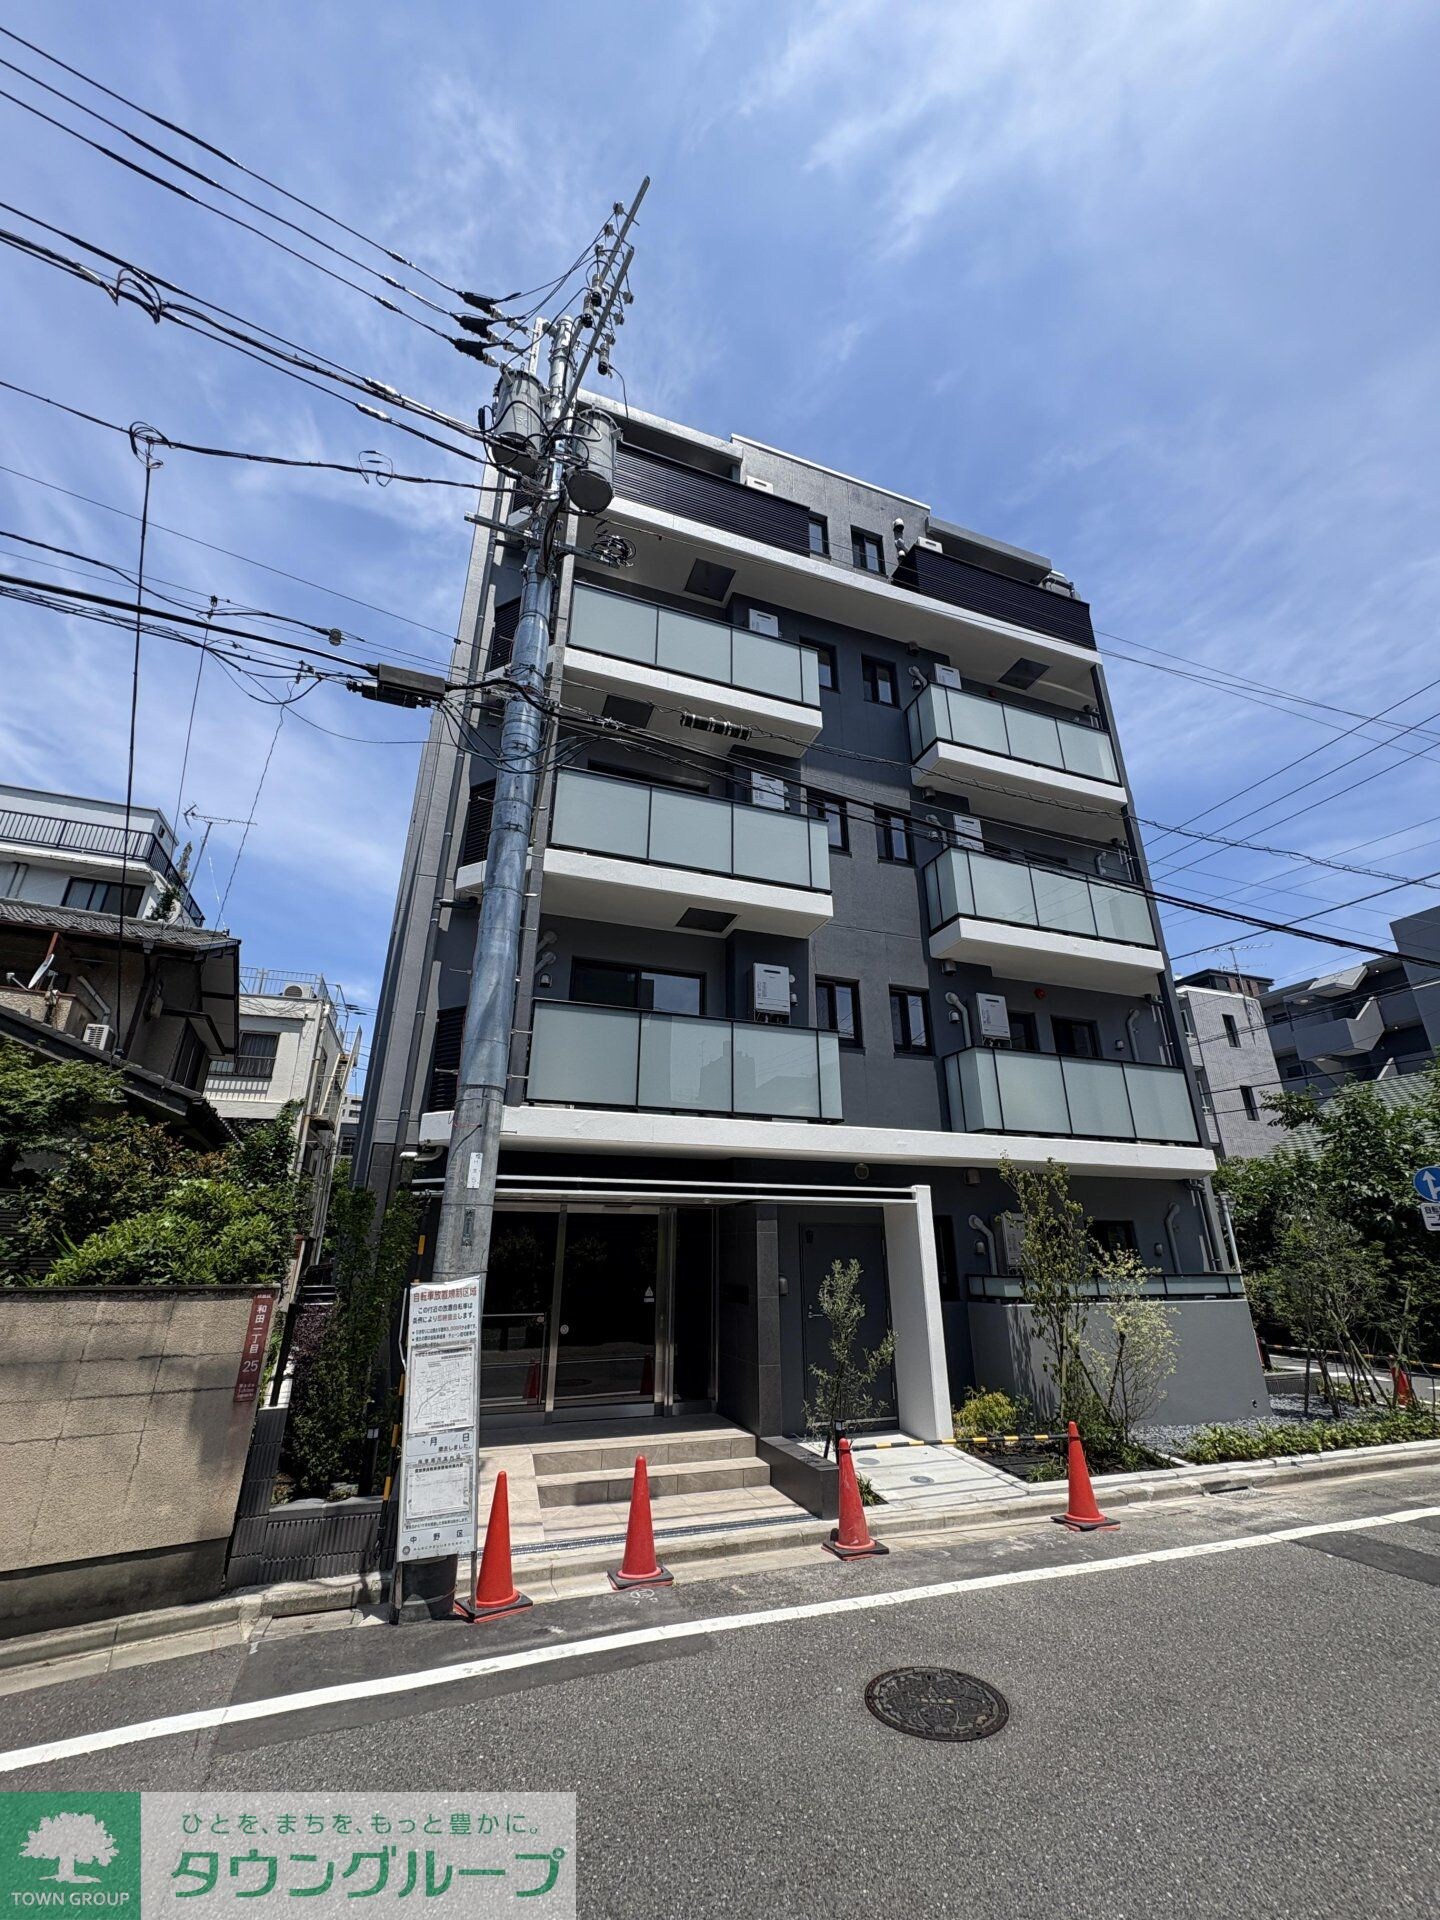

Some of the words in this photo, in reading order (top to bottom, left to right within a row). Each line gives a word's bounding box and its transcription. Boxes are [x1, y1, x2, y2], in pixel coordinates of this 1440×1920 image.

[249, 1304, 268, 1354] 和田一丁目
[242, 1360, 259, 1373] 25
[430, 1436, 437, 1446] 月
[462, 1432, 470, 1442] 日
[410, 1529, 464, 1544] 中野区
